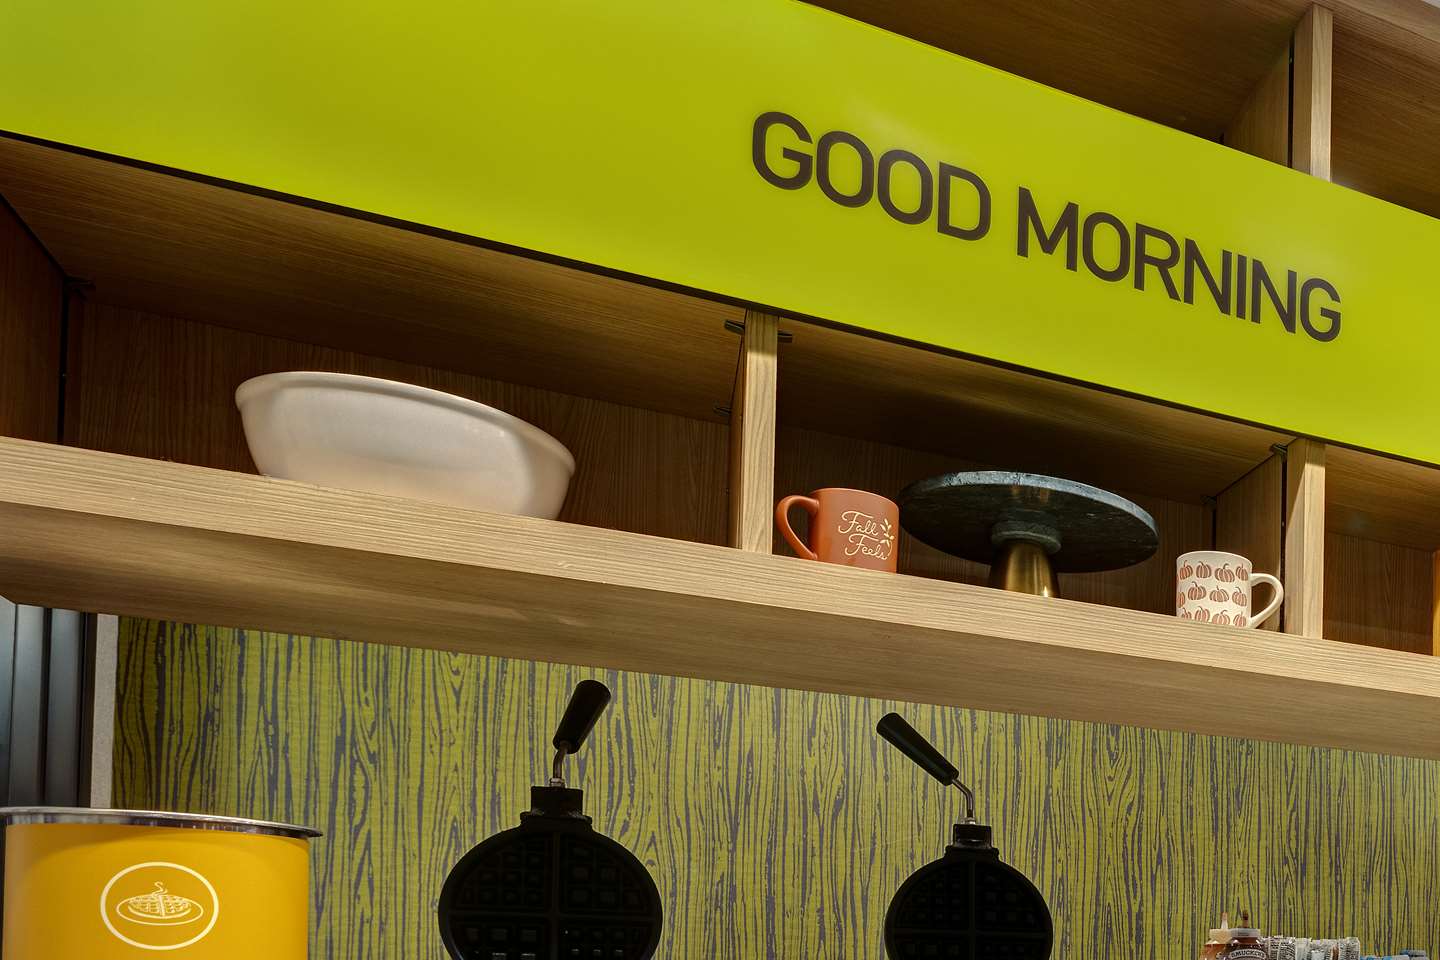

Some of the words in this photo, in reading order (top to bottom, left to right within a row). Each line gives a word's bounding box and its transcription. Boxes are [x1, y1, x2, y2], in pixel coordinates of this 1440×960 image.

[752, 111, 991, 241] GOOD
[1016, 186, 1342, 342] MORNING
[838, 511, 879, 536] Fall
